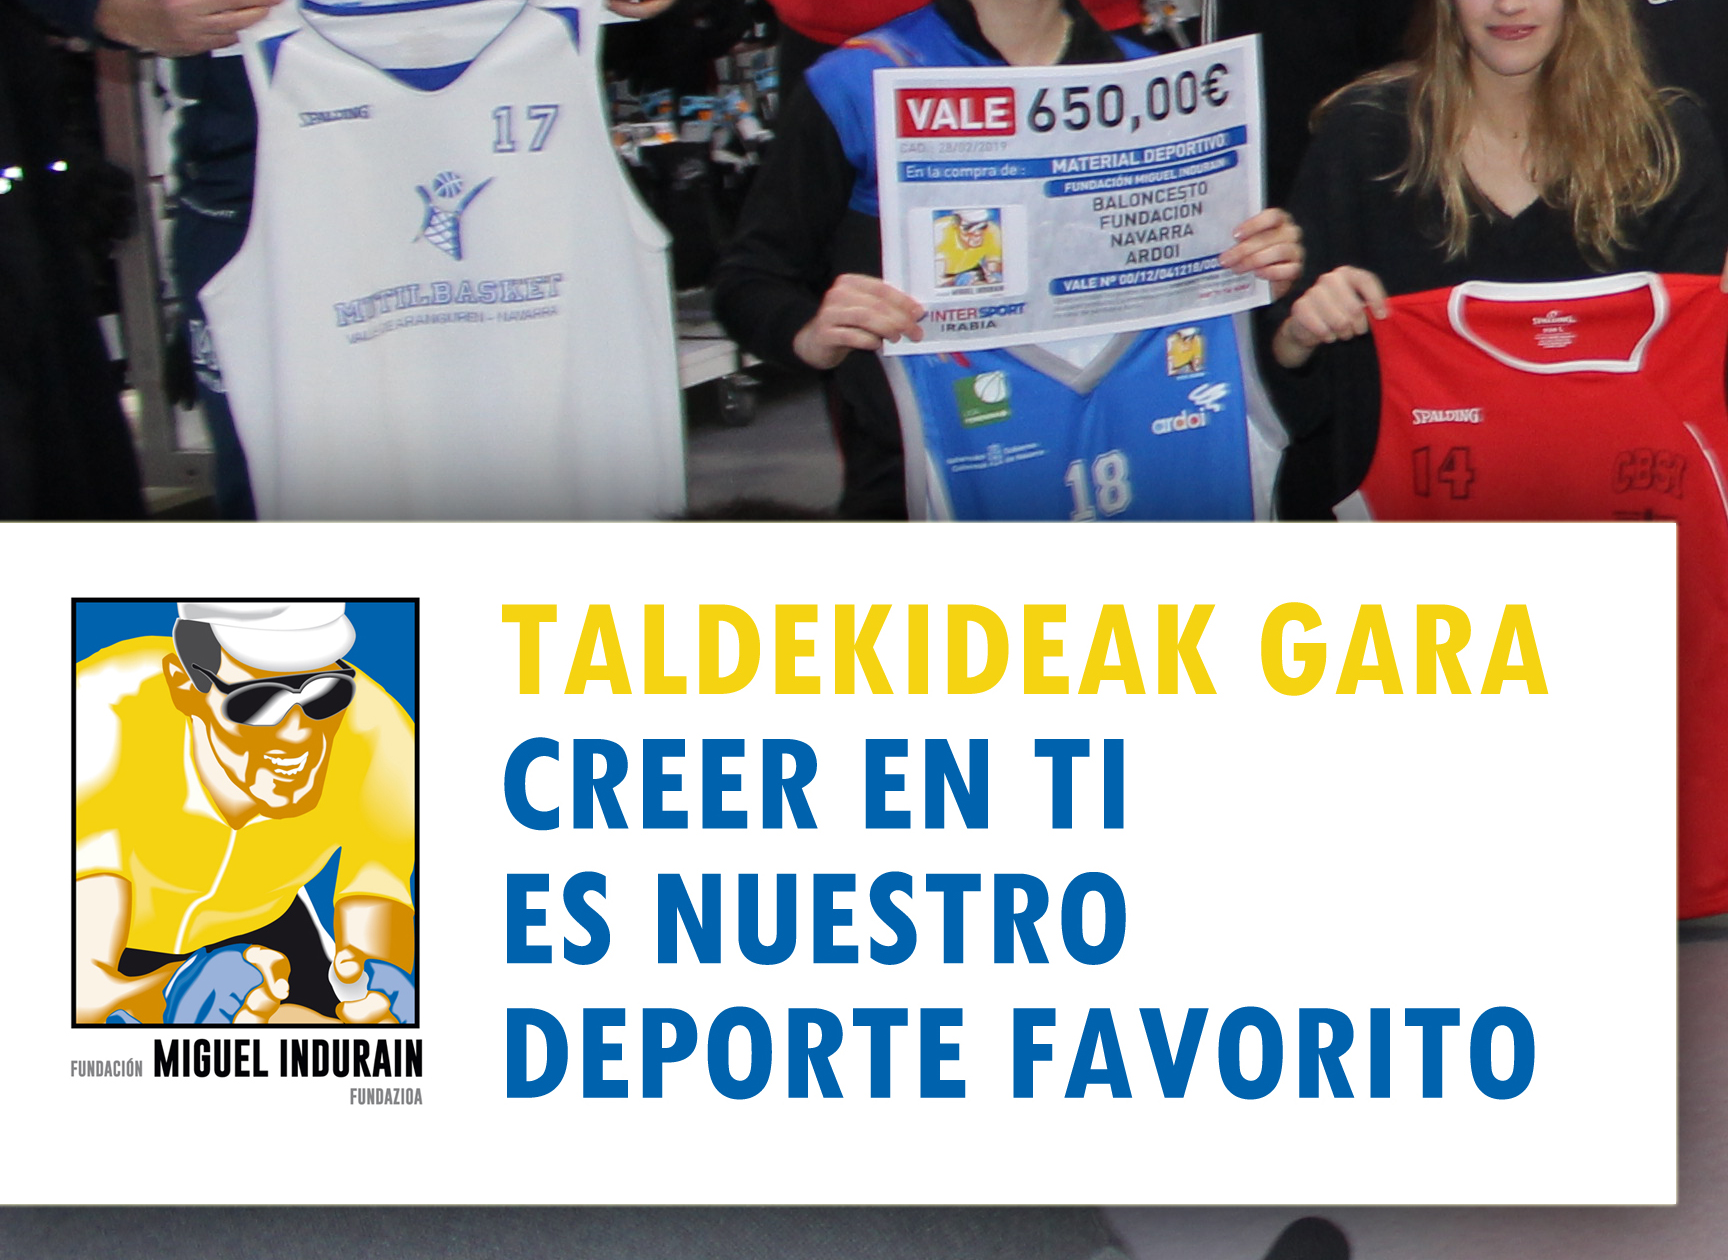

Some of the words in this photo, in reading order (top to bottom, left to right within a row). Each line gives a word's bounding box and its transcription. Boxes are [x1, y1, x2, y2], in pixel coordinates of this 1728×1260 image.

[906, 96, 1010, 131] VALE
[1027, 63, 1231, 134] 650,00€
[492, 105, 559, 153] 17
[1052, 152, 1139, 174] MATERIAL
[1144, 134, 1225, 163] DEPORTIVO
[905, 165, 920, 177] En
[924, 165, 935, 177] la
[940, 165, 996, 180] compra
[1000, 164, 1015, 176] de
[1093, 181, 1208, 211] BALONCESTO
[1111, 224, 1194, 247] NAVARRA
[1126, 244, 1180, 265] ARDOI
[929, 302, 1026, 322] INTERSPORT
[940, 319, 997, 332] IRABIA
[1151, 408, 1207, 435] ardoi
[1412, 408, 1480, 425] SPALDING
[1064, 448, 1131, 523] 18
[1412, 445, 1476, 500] 14
